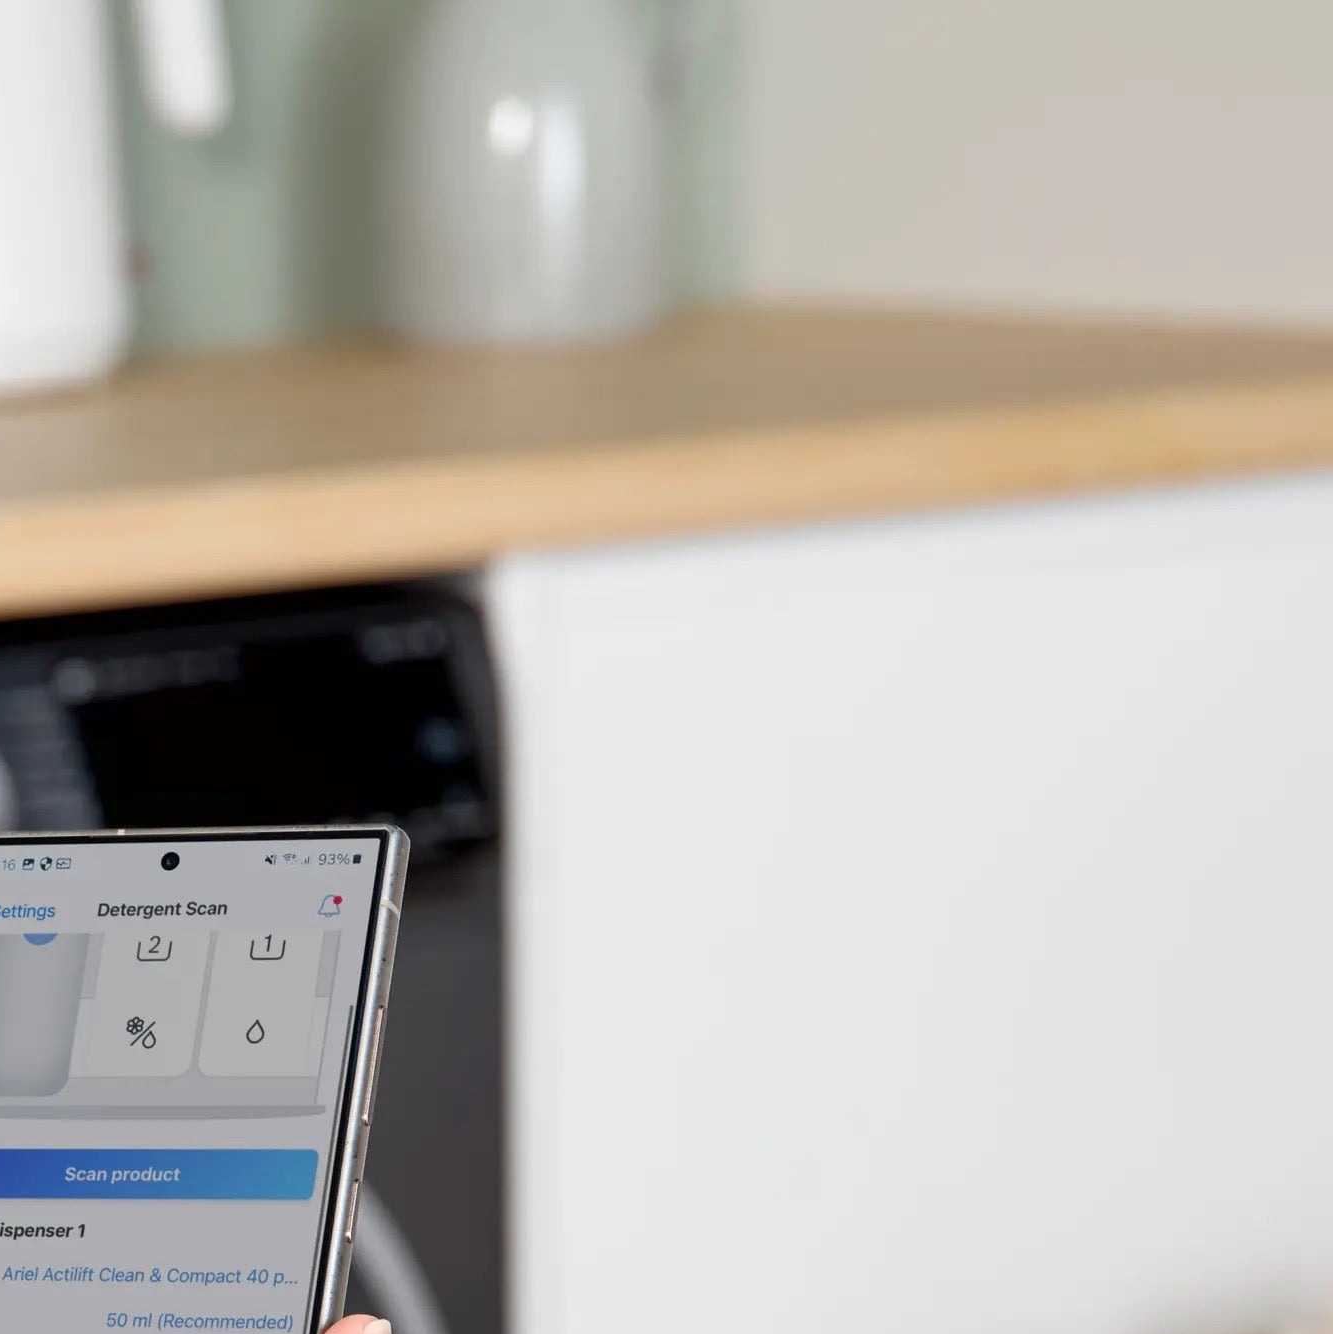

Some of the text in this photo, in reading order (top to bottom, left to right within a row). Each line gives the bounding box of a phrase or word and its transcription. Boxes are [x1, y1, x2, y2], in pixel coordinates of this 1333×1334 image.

[319, 852, 350, 865] 93%
[97, 901, 227, 919] Detergent Scan
[148, 936, 161, 953] 2
[265, 934, 272, 952] 1
[65, 1167, 181, 1184] Scan product
[78, 1224, 85, 1238] 1
[2, 1266, 39, 1281] Ariel
[42, 1267, 94, 1282] Actilift
[99, 1268, 144, 1282] Clean
[150, 1268, 161, 1282] &
[167, 1268, 241, 1286] Compact
[247, 1269, 269, 1284] 40
[106, 1312, 128, 1327] 50
[133, 1313, 152, 1328] ml
[158, 1312, 293, 1333] (Recommended)
